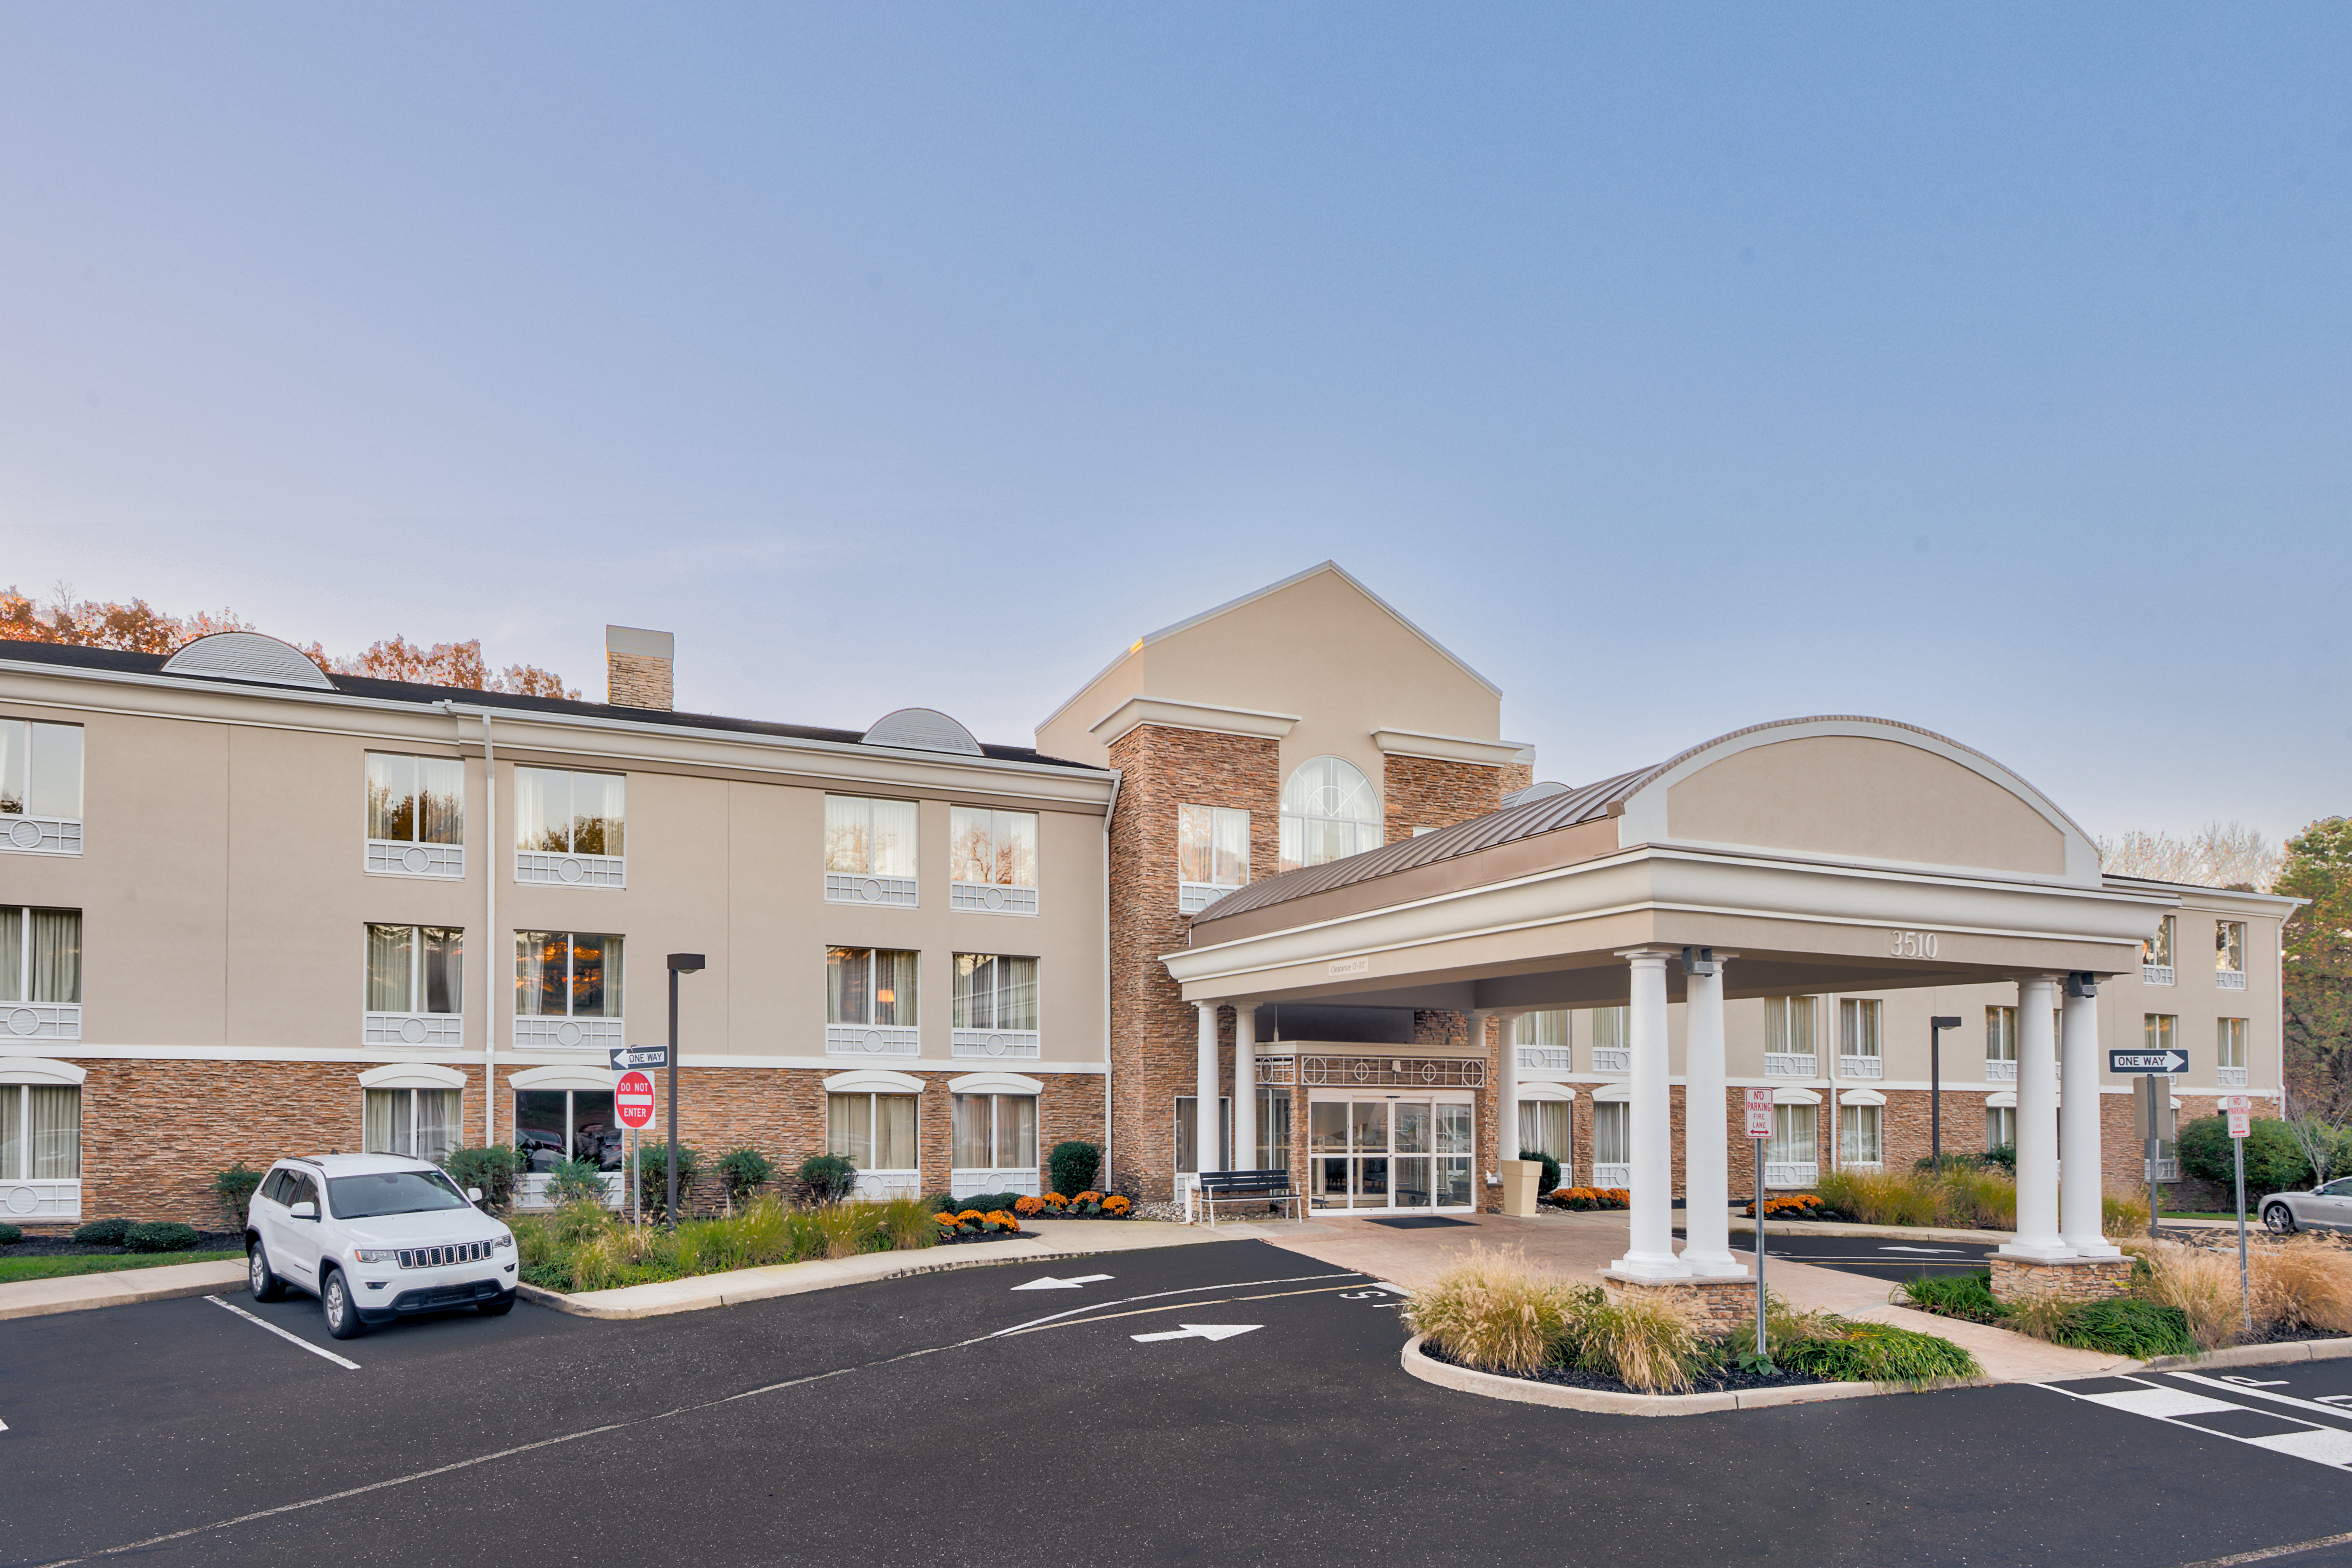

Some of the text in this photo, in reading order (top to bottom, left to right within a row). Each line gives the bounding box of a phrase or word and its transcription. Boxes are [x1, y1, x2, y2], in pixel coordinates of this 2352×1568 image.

[1890, 931, 1938, 959] 3510
[1331, 965, 1351, 973] Clearance
[629, 1052, 662, 1063] ONE WAY
[2118, 1056, 2165, 1066] ONE WAY
[621, 1083, 648, 1092] DO NOT
[1754, 1091, 1764, 1100] NO
[1747, 1102, 1771, 1111] PARKING
[624, 1108, 646, 1117] ENTER
